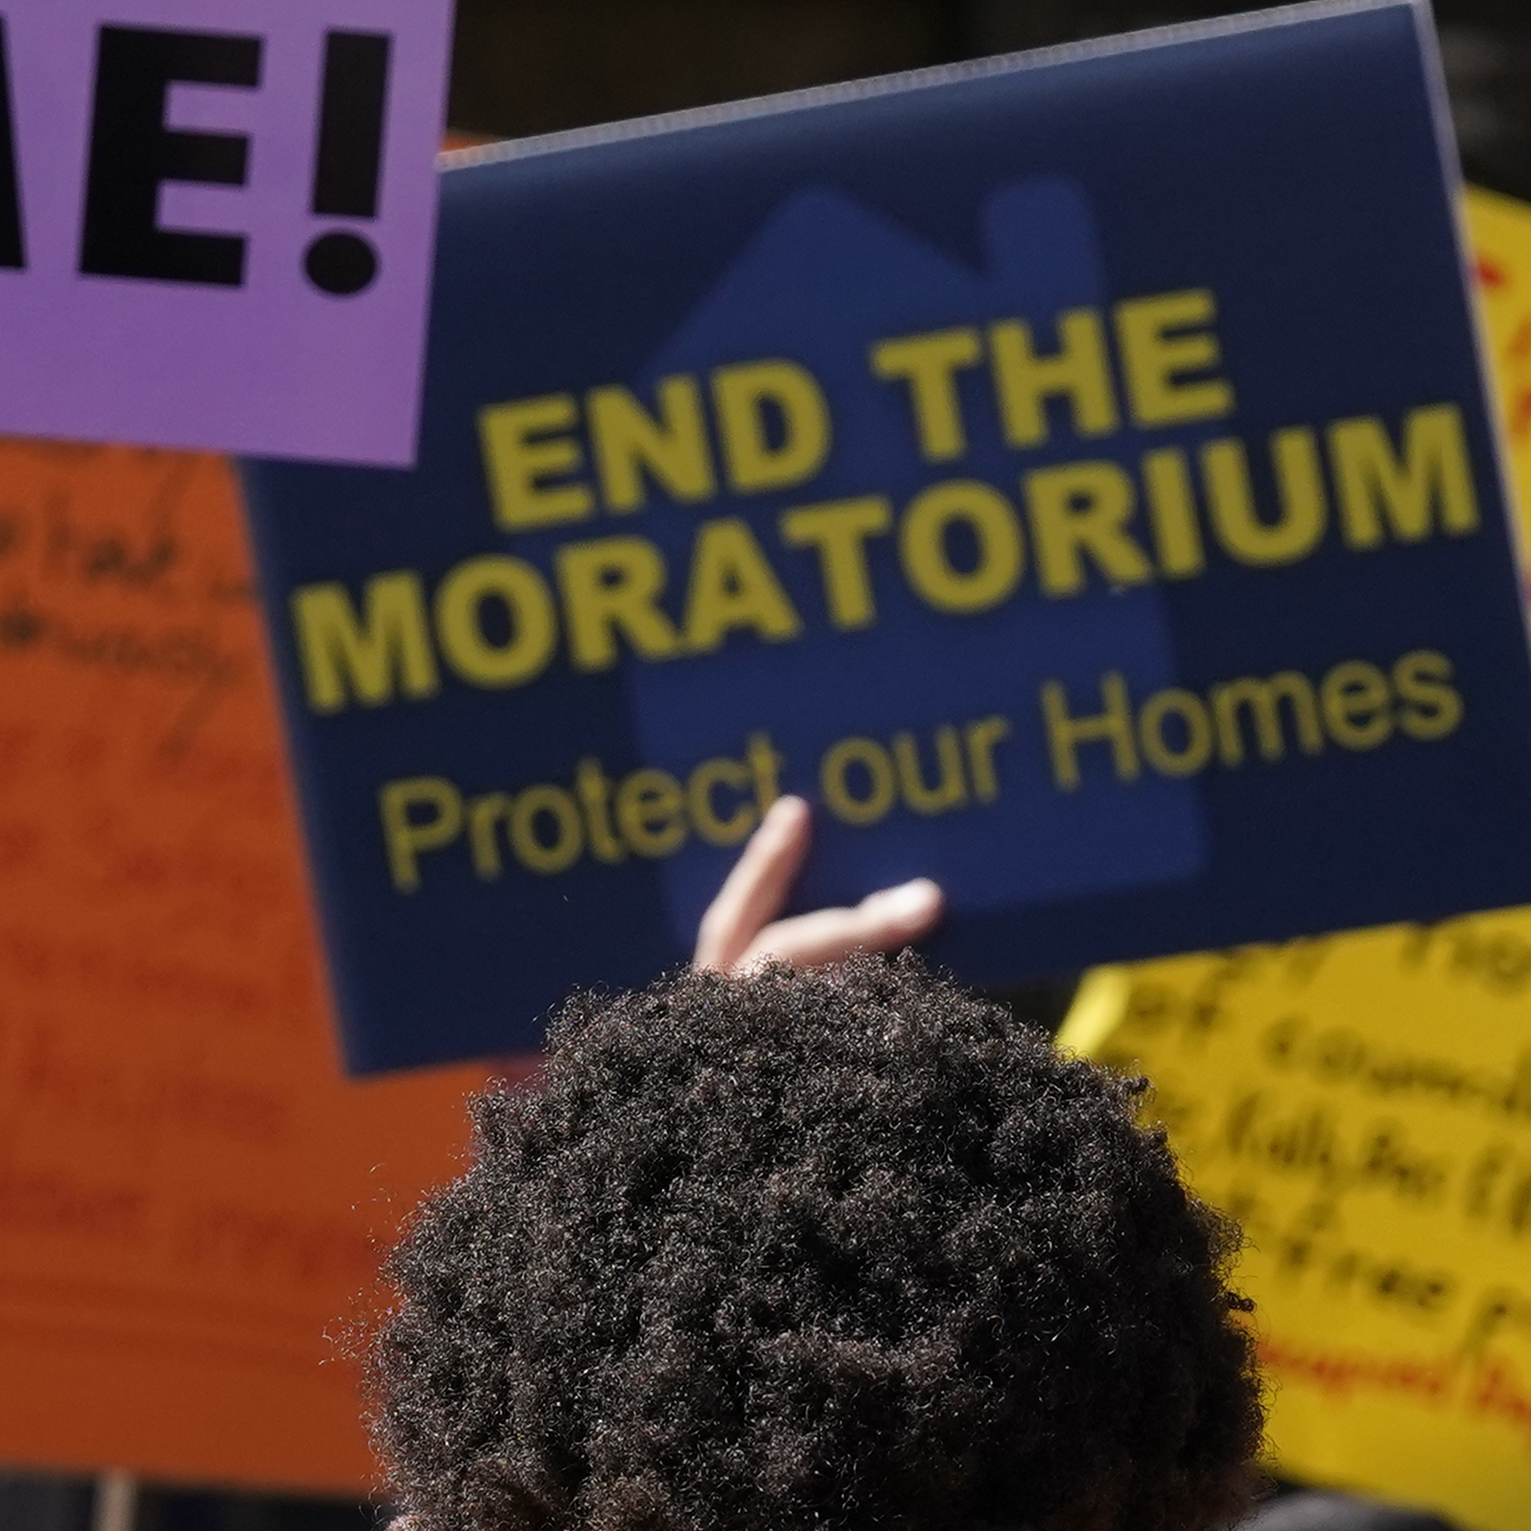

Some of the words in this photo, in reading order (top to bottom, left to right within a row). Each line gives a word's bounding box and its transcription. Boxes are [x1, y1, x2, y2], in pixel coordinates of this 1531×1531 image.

[477, 358, 833, 532] END
[871, 290, 1233, 463] THE
[293, 403, 1479, 714] MORATORIUM
[378, 728, 785, 892] Protect
[817, 713, 1011, 826] our
[1041, 650, 1464, 788] Homes
